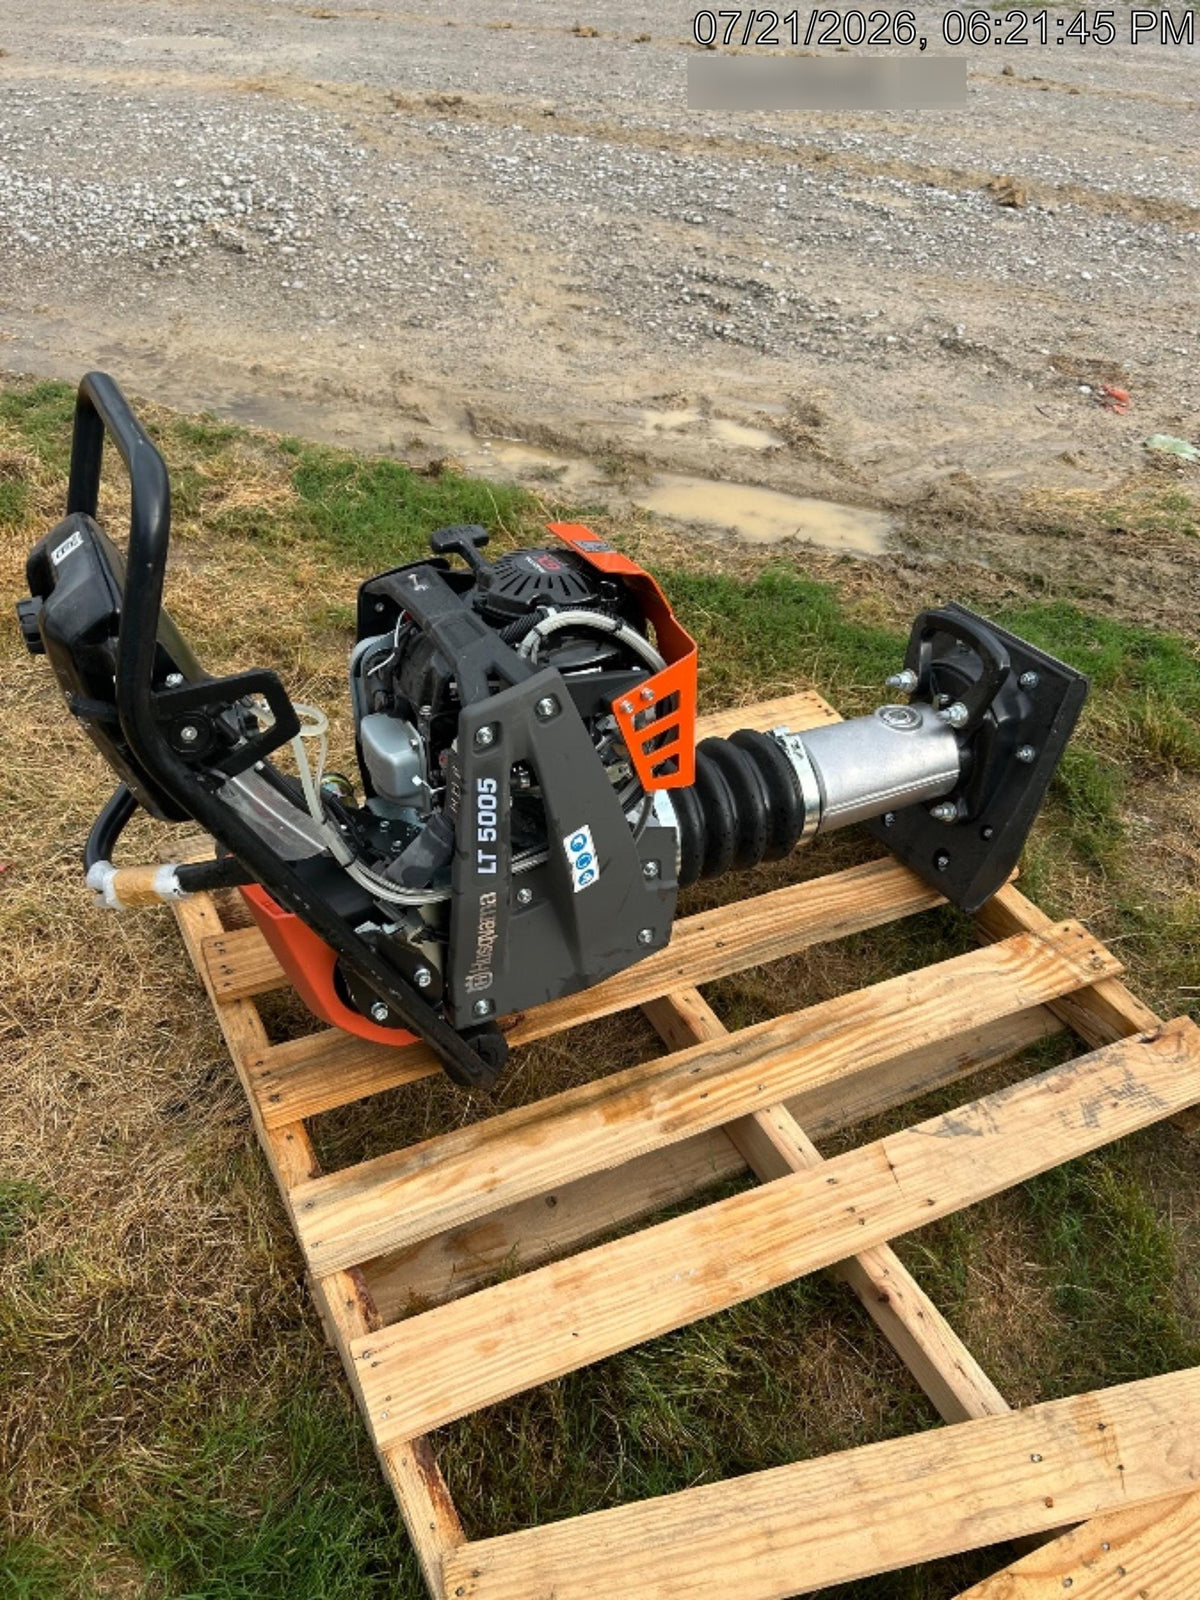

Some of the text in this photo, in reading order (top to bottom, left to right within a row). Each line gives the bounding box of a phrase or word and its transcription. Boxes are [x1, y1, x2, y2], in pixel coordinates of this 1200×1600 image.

[476, 777, 498, 875] LT 5005
[469, 891, 499, 974] Husqvarna
